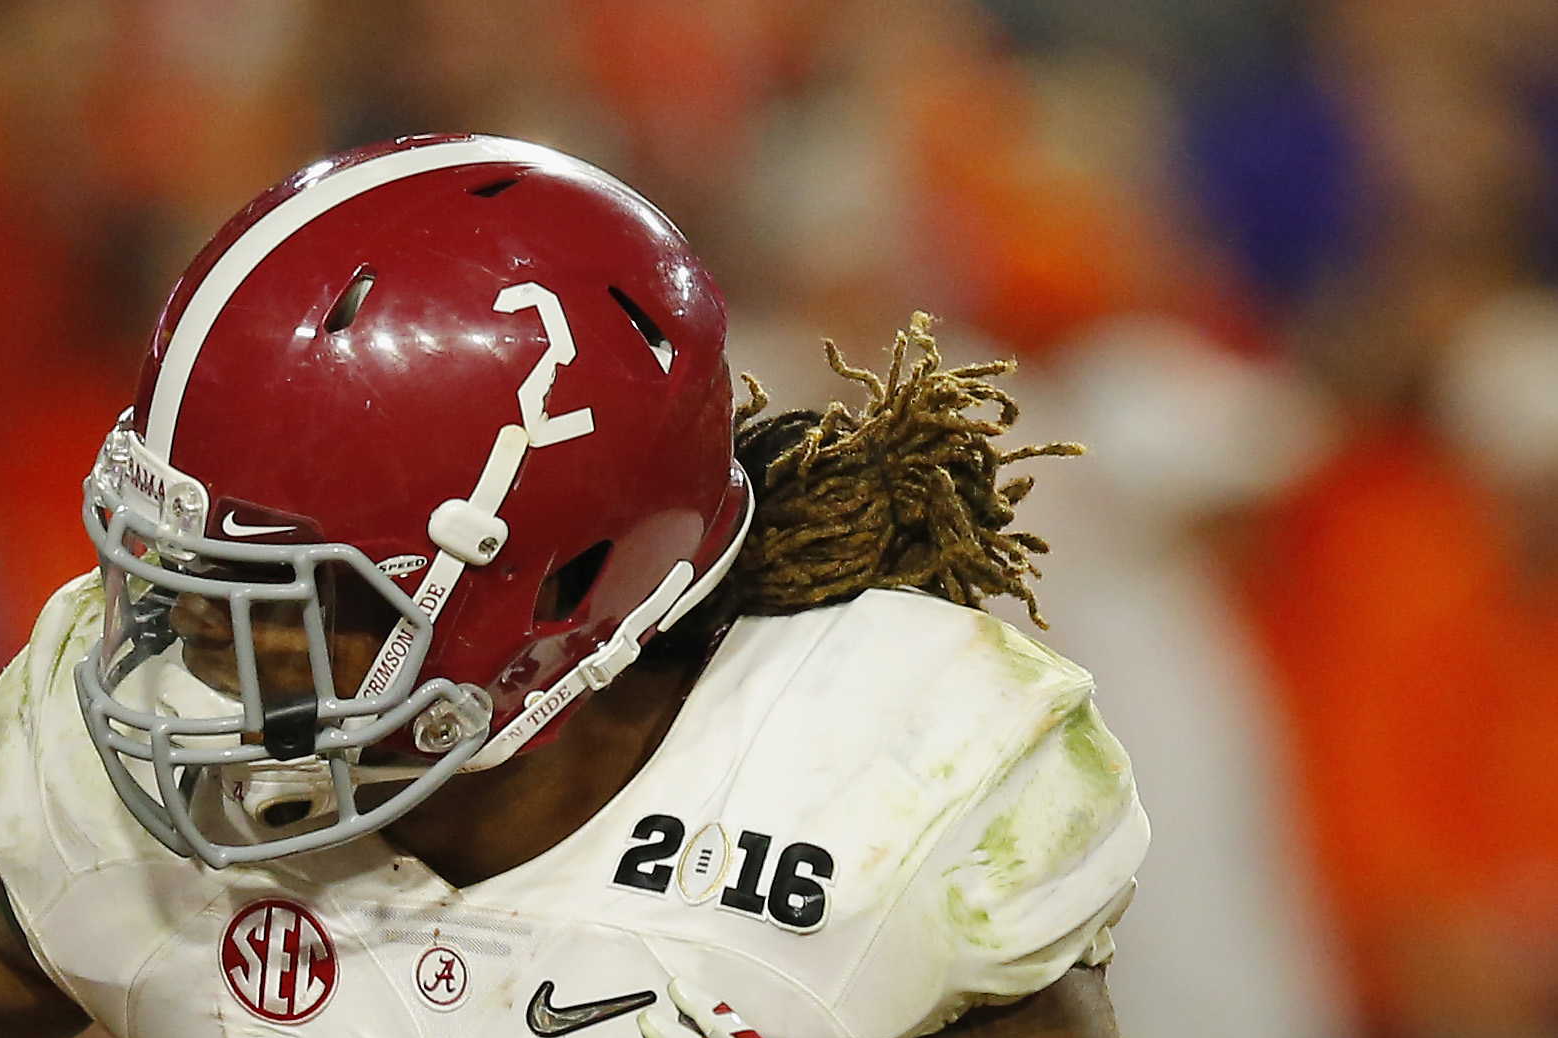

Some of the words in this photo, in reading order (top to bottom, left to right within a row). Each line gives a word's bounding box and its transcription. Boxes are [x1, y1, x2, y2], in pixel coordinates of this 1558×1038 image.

[493, 281, 595, 448] 2
[378, 558, 426, 573] SPEED
[526, 685, 573, 727] TIDE
[227, 906, 329, 1016] SEC
[423, 957, 456, 994] A
